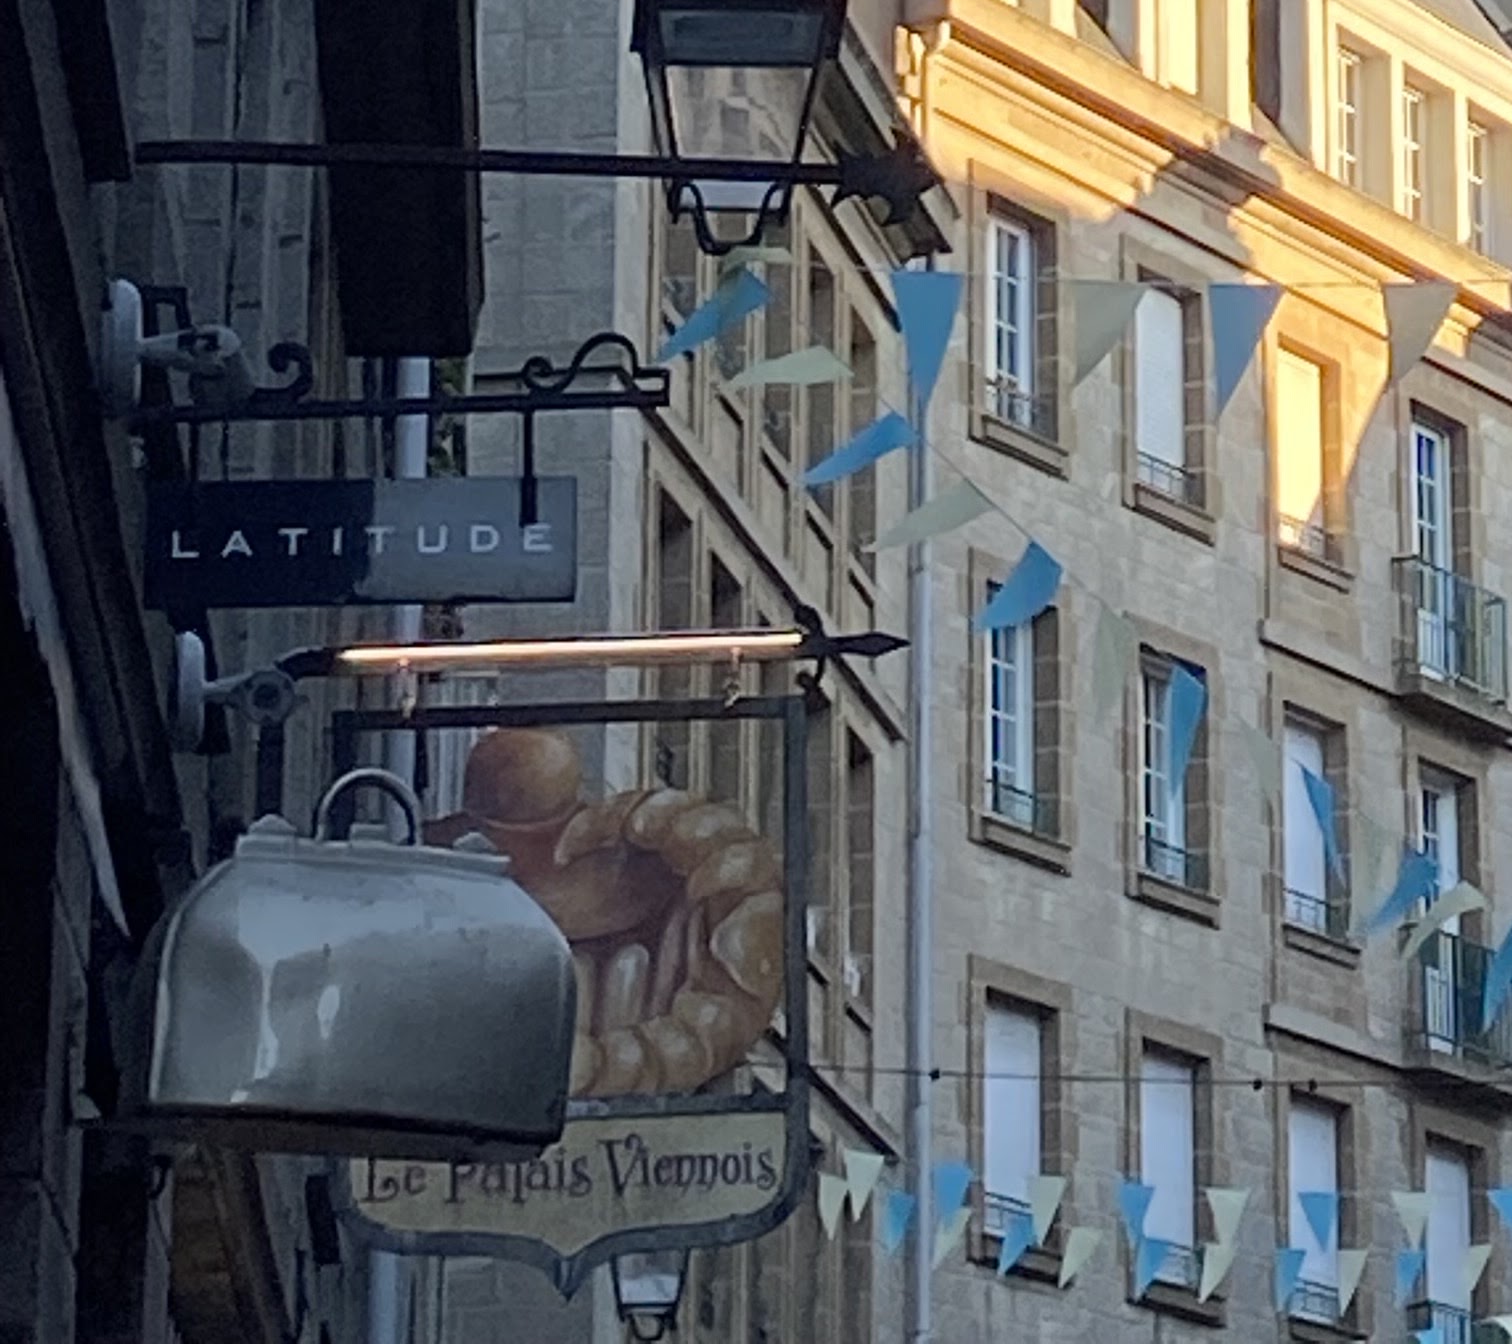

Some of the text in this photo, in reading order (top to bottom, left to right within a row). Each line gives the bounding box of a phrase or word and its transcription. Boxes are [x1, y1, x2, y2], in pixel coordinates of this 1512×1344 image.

[170, 524, 553, 559] LATITUDE
[360, 1157, 426, 1203] Le
[599, 1133, 778, 1196] Viennois
